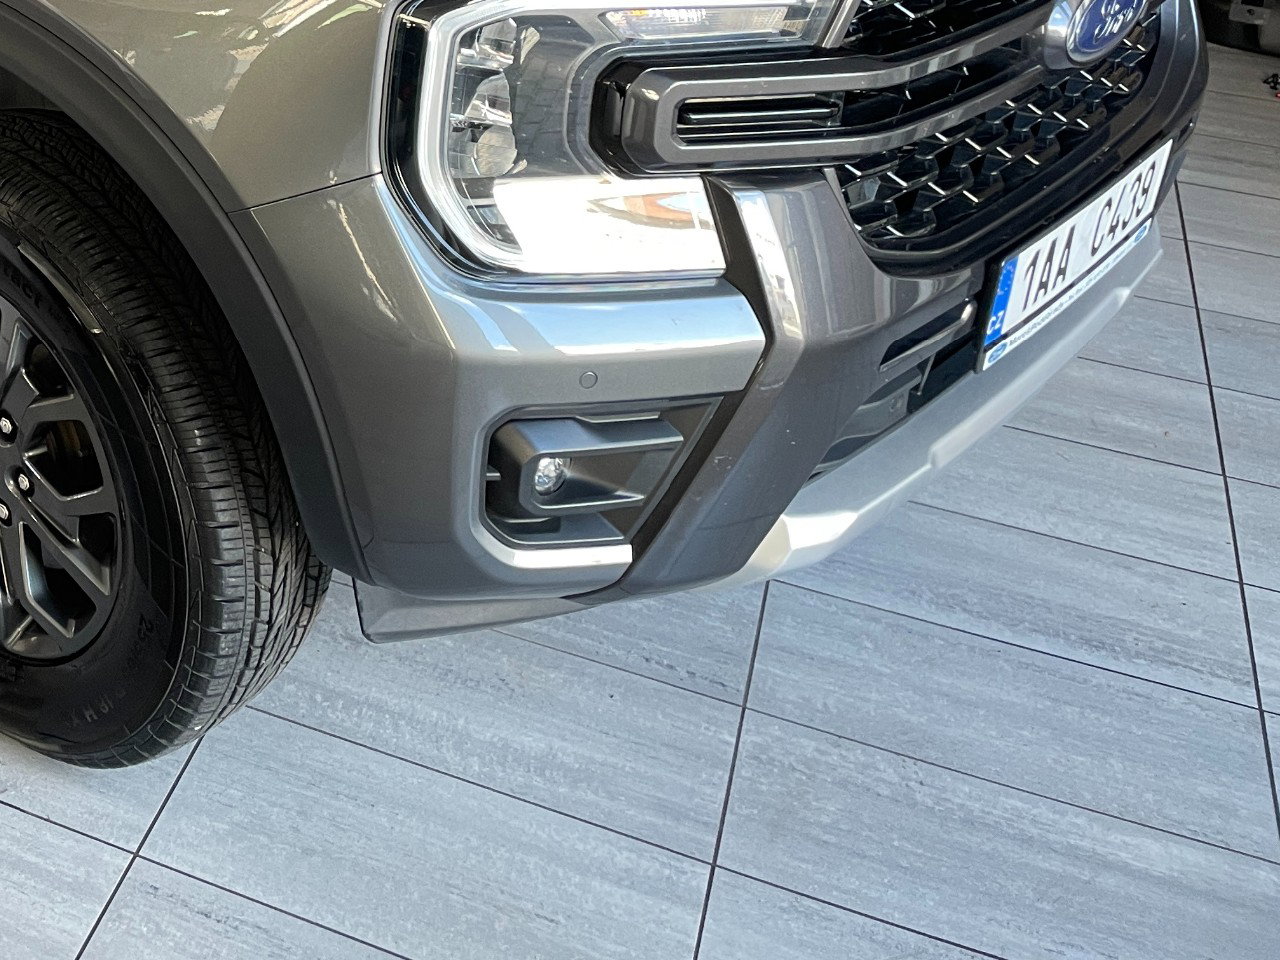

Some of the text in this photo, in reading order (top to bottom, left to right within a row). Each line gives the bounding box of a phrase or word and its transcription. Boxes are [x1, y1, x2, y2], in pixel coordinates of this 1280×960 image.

[1021, 224, 1076, 313] 1AA
[1090, 161, 1157, 257] C439
[985, 310, 1005, 336] CZ
